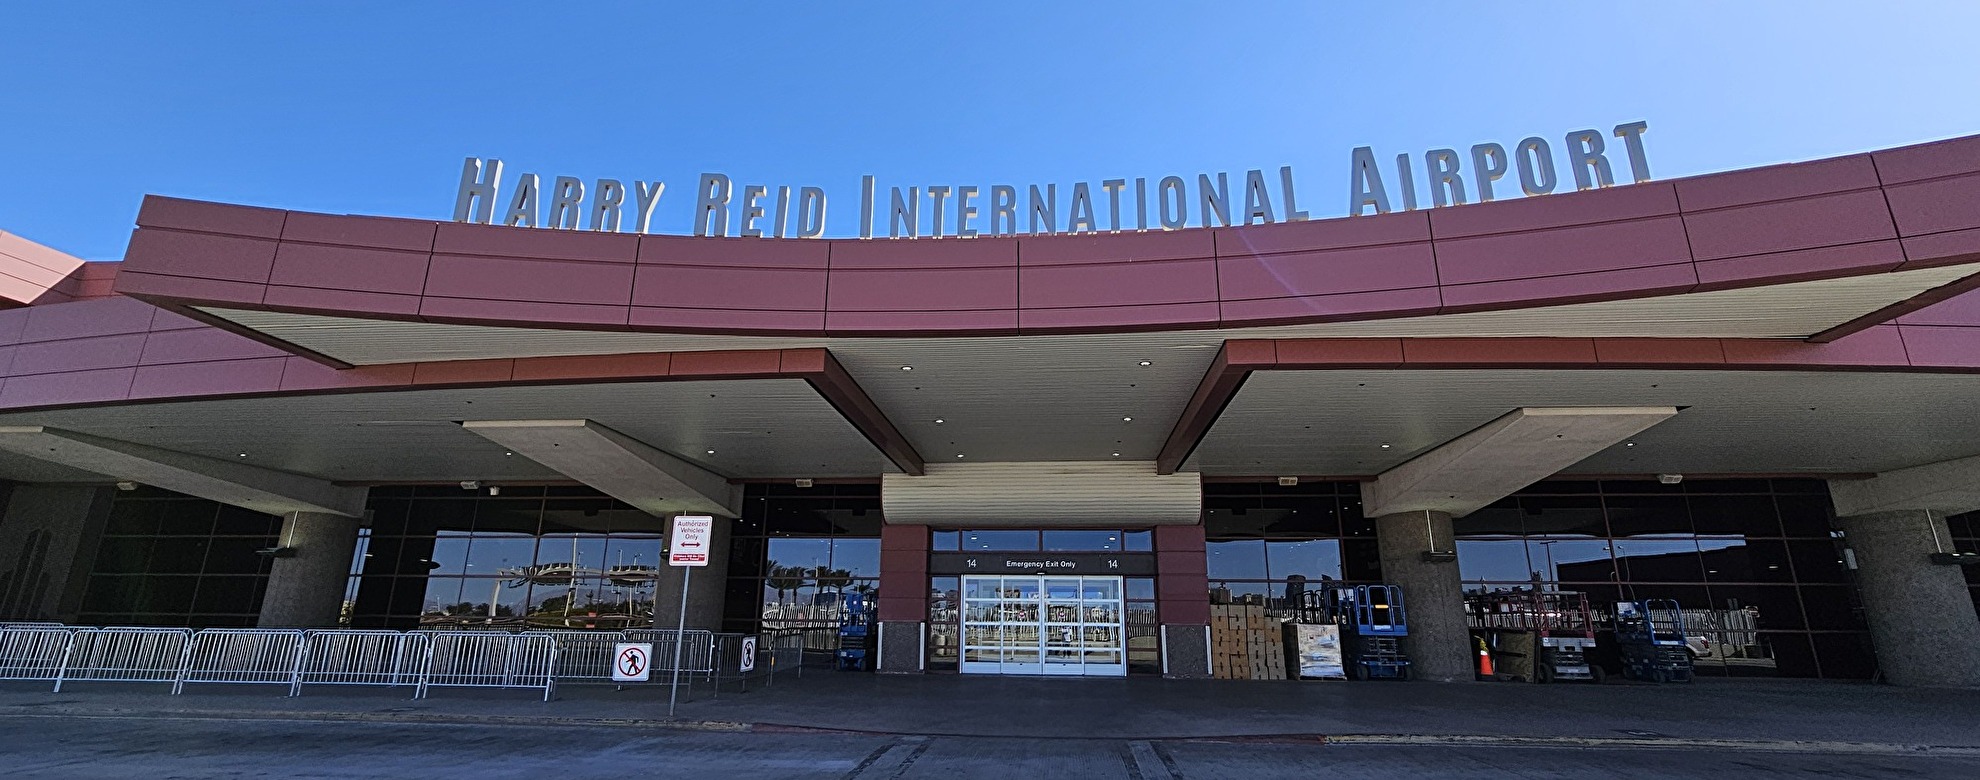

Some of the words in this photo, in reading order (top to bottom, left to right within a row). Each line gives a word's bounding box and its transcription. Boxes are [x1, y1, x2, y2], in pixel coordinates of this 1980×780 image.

[452, 157, 665, 234] HARRY
[694, 173, 826, 239] REID
[859, 165, 1309, 239] INTERNATIONAL
[1349, 120, 1651, 217] AIRPORT
[966, 559, 977, 568] 14
[1006, 560, 1044, 569] Emergency
[1046, 560, 1059, 568] Exit
[1060, 560, 1076, 569] Only
[1108, 560, 1118, 569] 14
